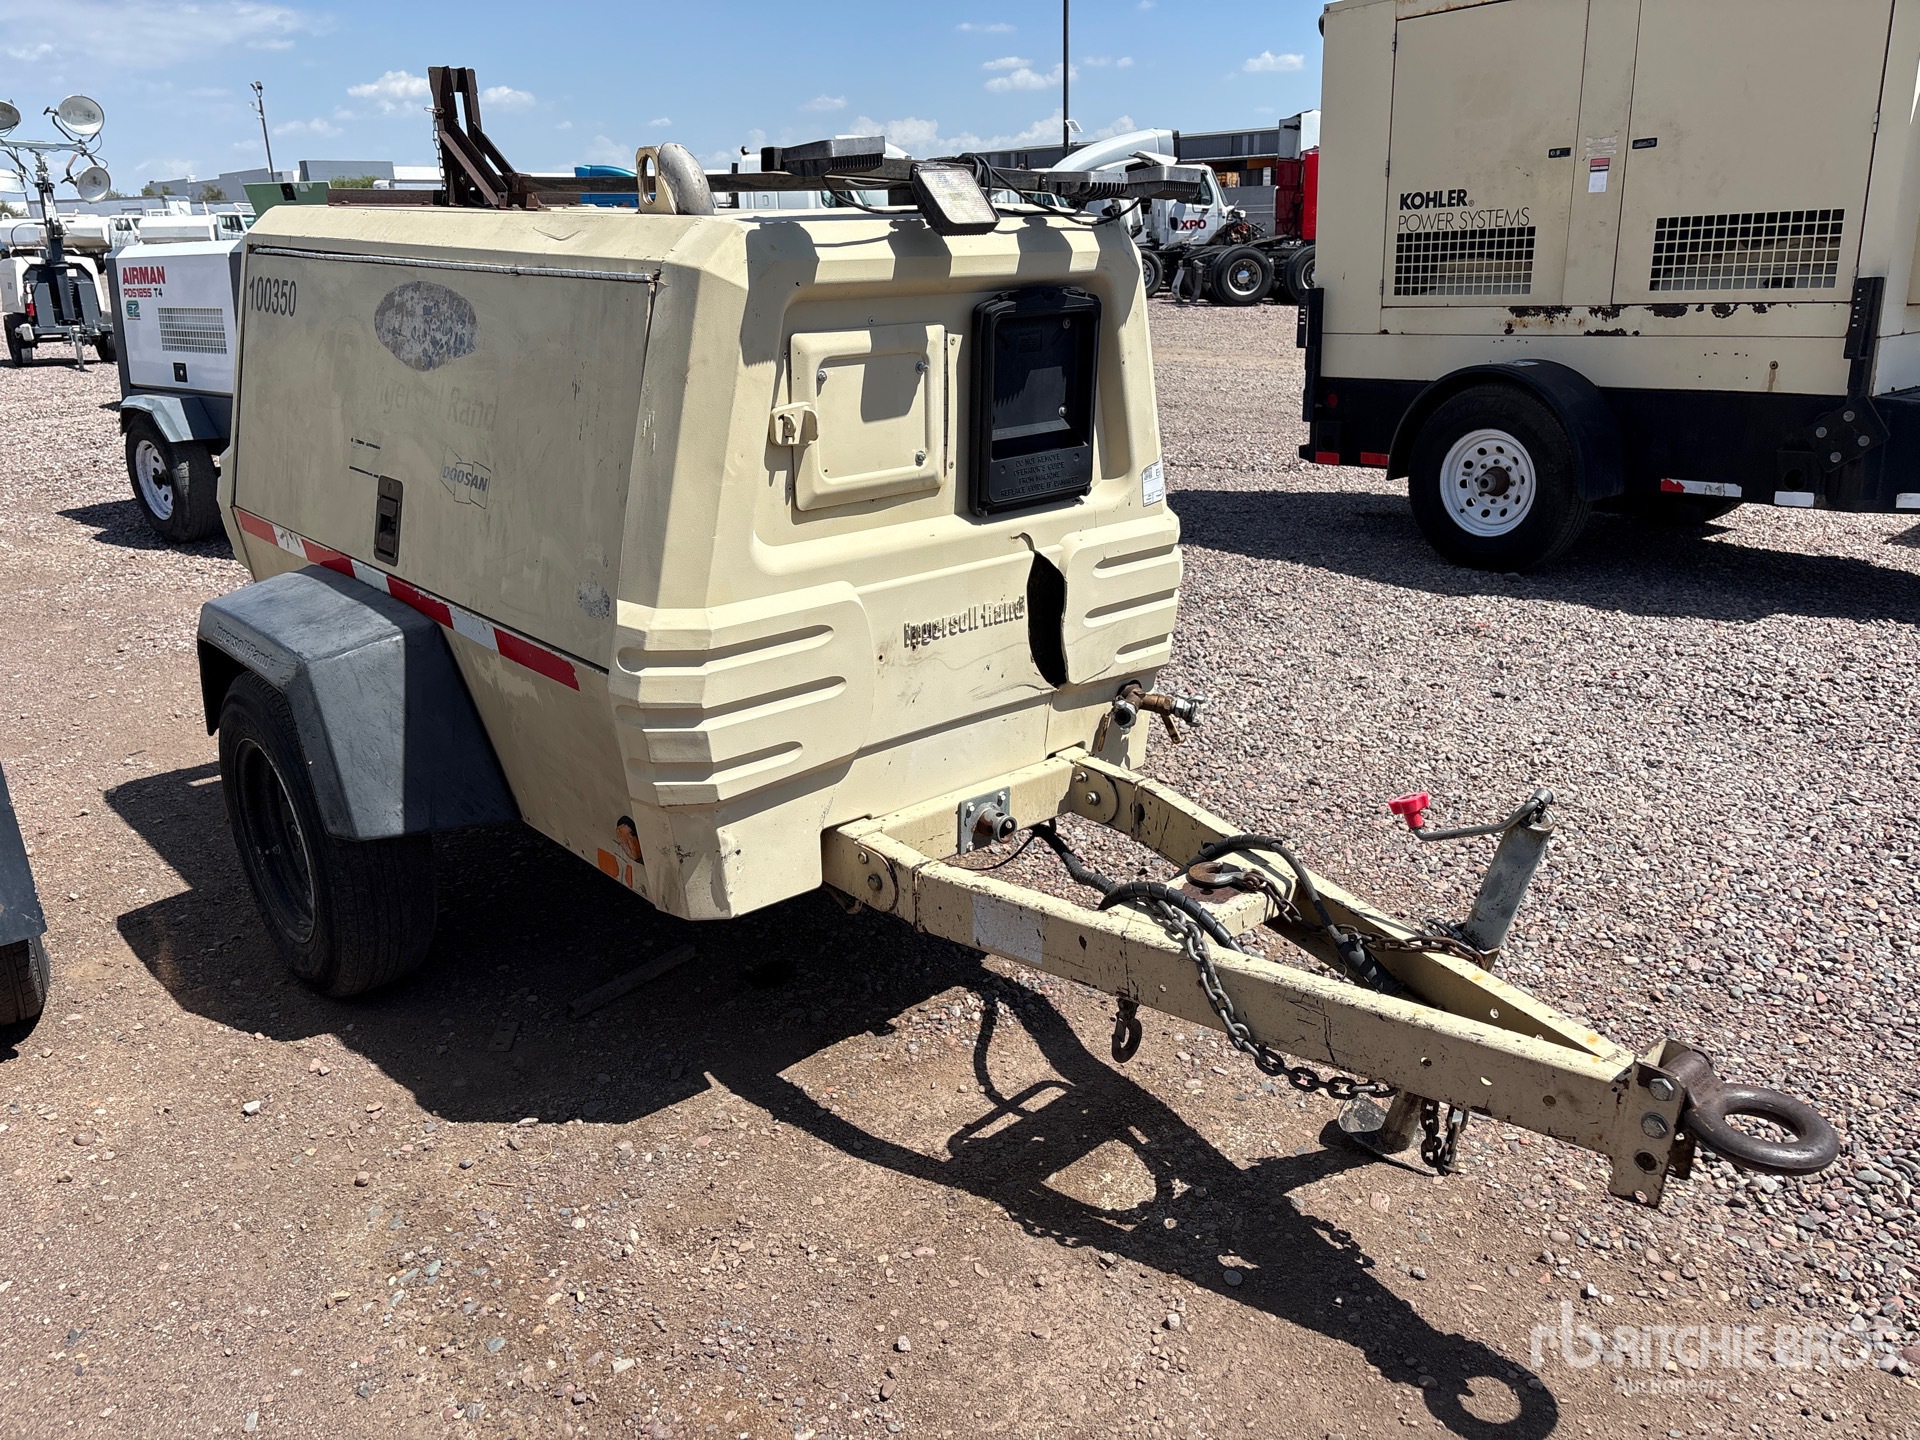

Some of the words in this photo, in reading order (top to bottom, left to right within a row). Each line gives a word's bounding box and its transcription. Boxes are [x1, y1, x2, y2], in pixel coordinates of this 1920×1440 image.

[1399, 189, 1468, 211] KOHLER
[1180, 219, 1207, 231] XPO
[1398, 212, 1454, 232] POWER
[1458, 206, 1530, 230] SYSTEMS
[122, 266, 166, 285] AIRMAN
[153, 287, 163, 298] T4
[249, 276, 297, 317] 100350
[442, 465, 488, 492] DOOSAN
